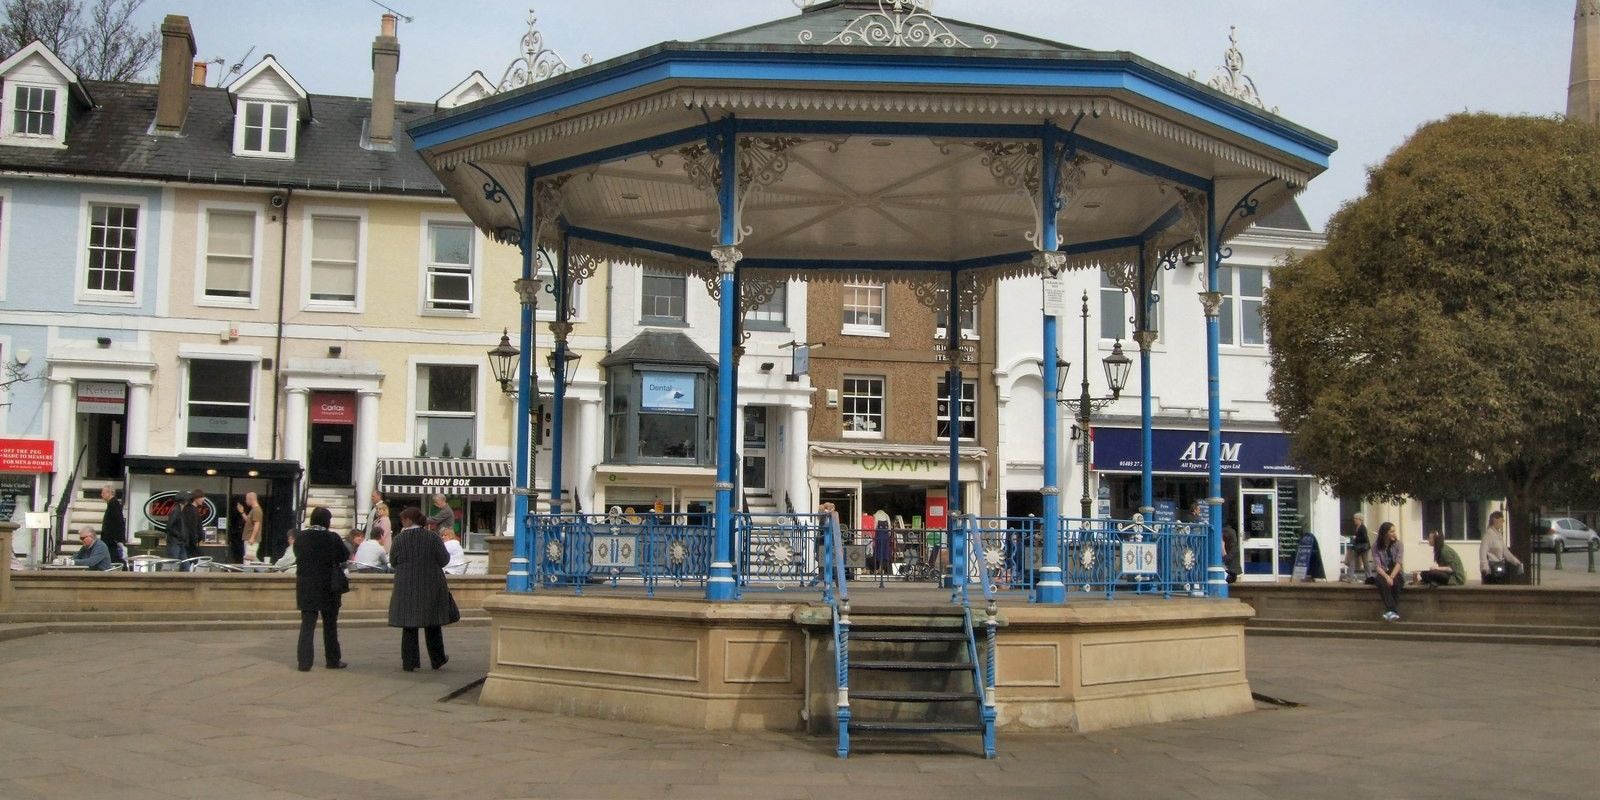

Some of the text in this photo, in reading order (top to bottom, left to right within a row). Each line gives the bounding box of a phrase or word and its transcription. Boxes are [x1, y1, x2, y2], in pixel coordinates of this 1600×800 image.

[861, 457, 930, 472] OXFAM
[422, 478, 471, 487] CANDY BOX
